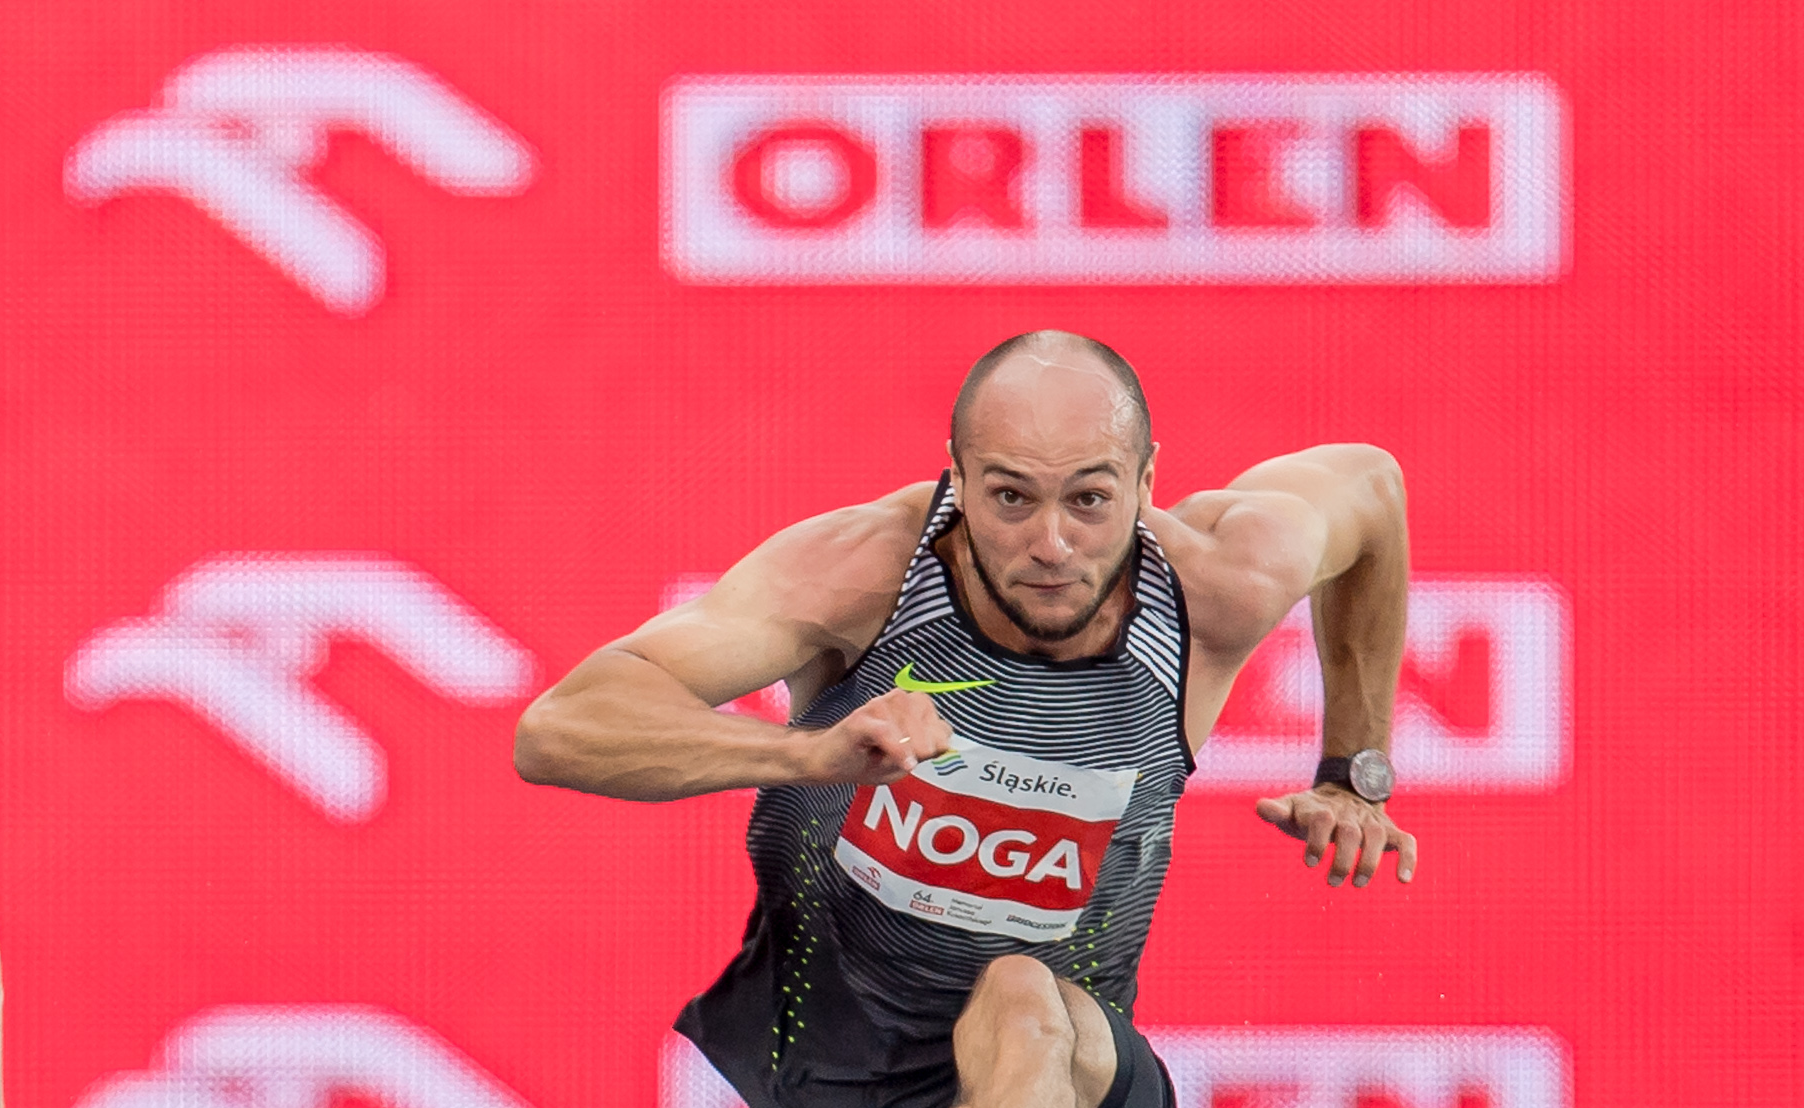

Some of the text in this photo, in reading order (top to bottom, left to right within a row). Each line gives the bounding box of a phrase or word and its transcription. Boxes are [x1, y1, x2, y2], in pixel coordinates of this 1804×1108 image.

[732, 119, 1493, 231] ORLEN
[978, 760, 1078, 799] Śląskie.
[863, 783, 1083, 891] NOGA
